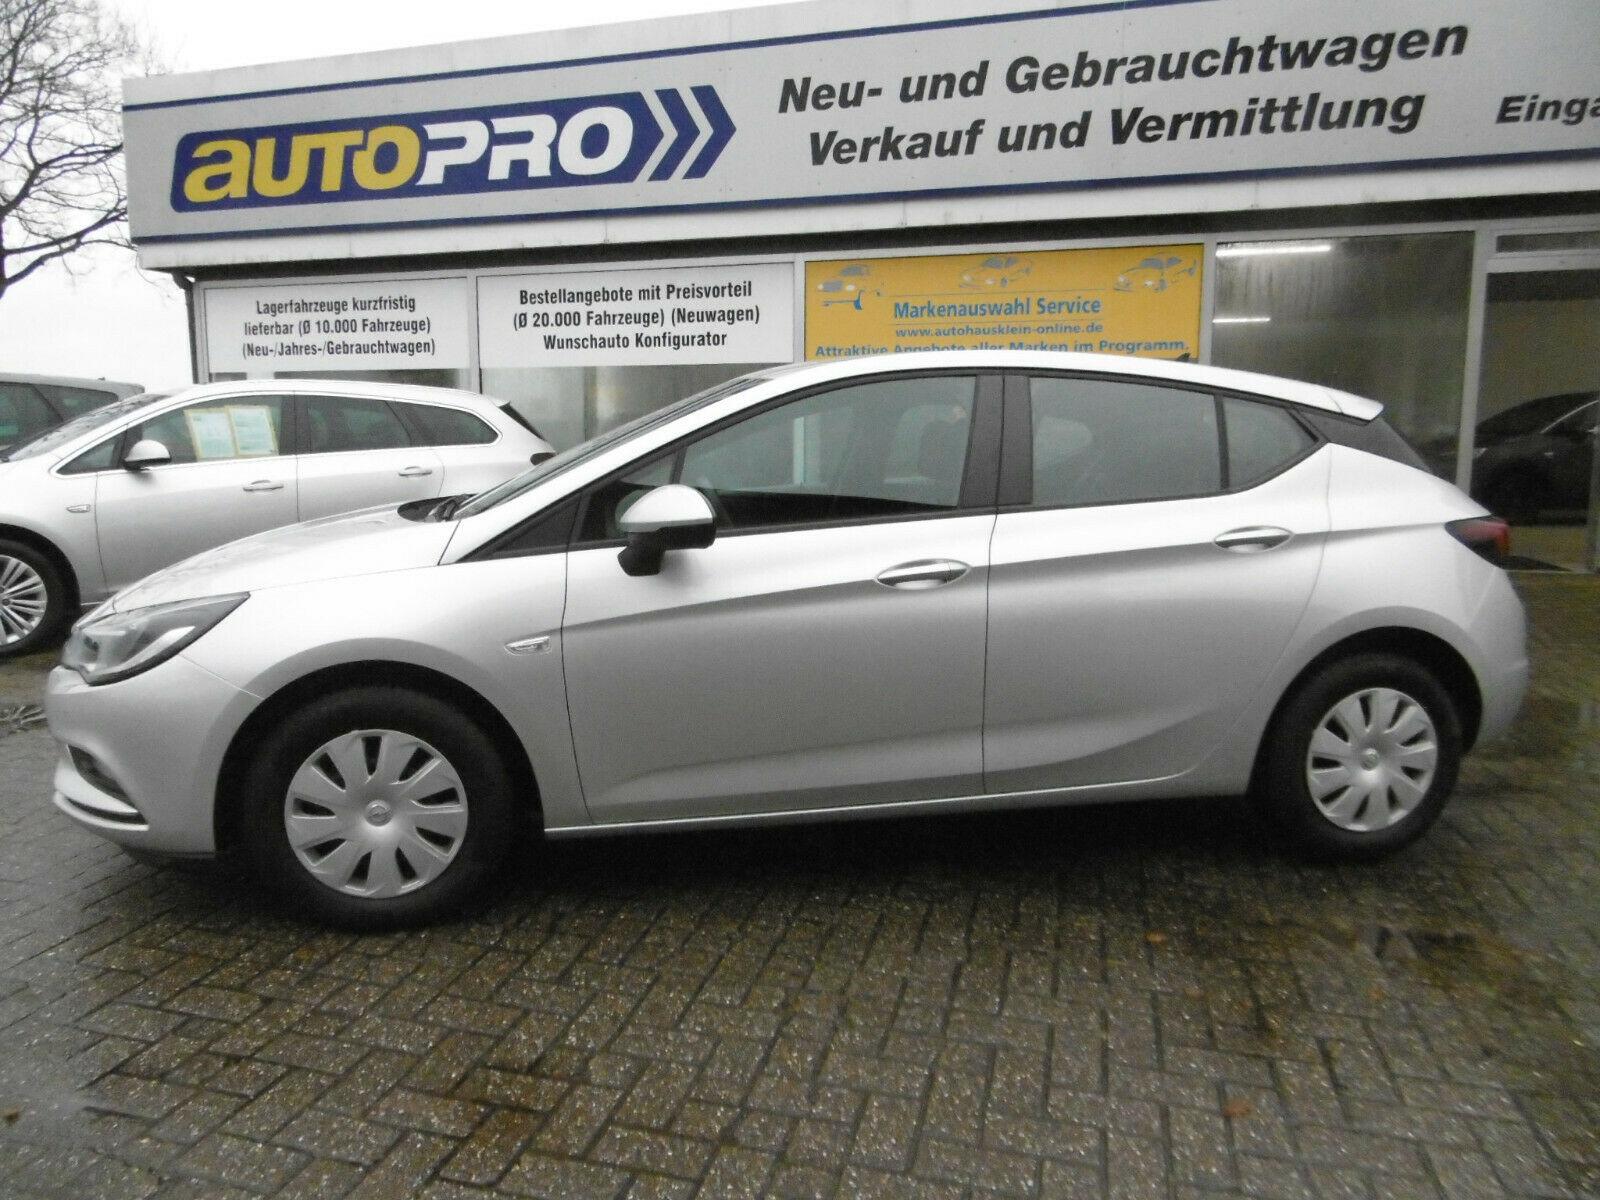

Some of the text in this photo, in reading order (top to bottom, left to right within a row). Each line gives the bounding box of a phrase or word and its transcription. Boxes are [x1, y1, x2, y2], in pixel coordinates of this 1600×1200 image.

[777, 24, 1469, 113] Neu- und Gebrauchtwagen
[809, 92, 1426, 166] Verkauf und Vermittlung
[519, 280, 752, 306] Bestellangebote mit Preisvorteil
[256, 295, 416, 317] Lagerfahrzeuge kurzfristig
[532, 310, 581, 328] 20.000
[586, 308, 664, 329] Fahrzeuge)
[671, 304, 760, 326] (Neuwagen)
[894, 295, 1101, 319] Markenauswahl Service
[244, 321, 294, 336] lieferbar
[315, 318, 357, 335] 10.000
[362, 316, 431, 335] Fahrzeuge)
[895, 322, 1103, 338] www.autohausklein-online.de
[543, 331, 727, 351] Wunschauto Konfigurator
[815, 344, 888, 357] Attraktive
